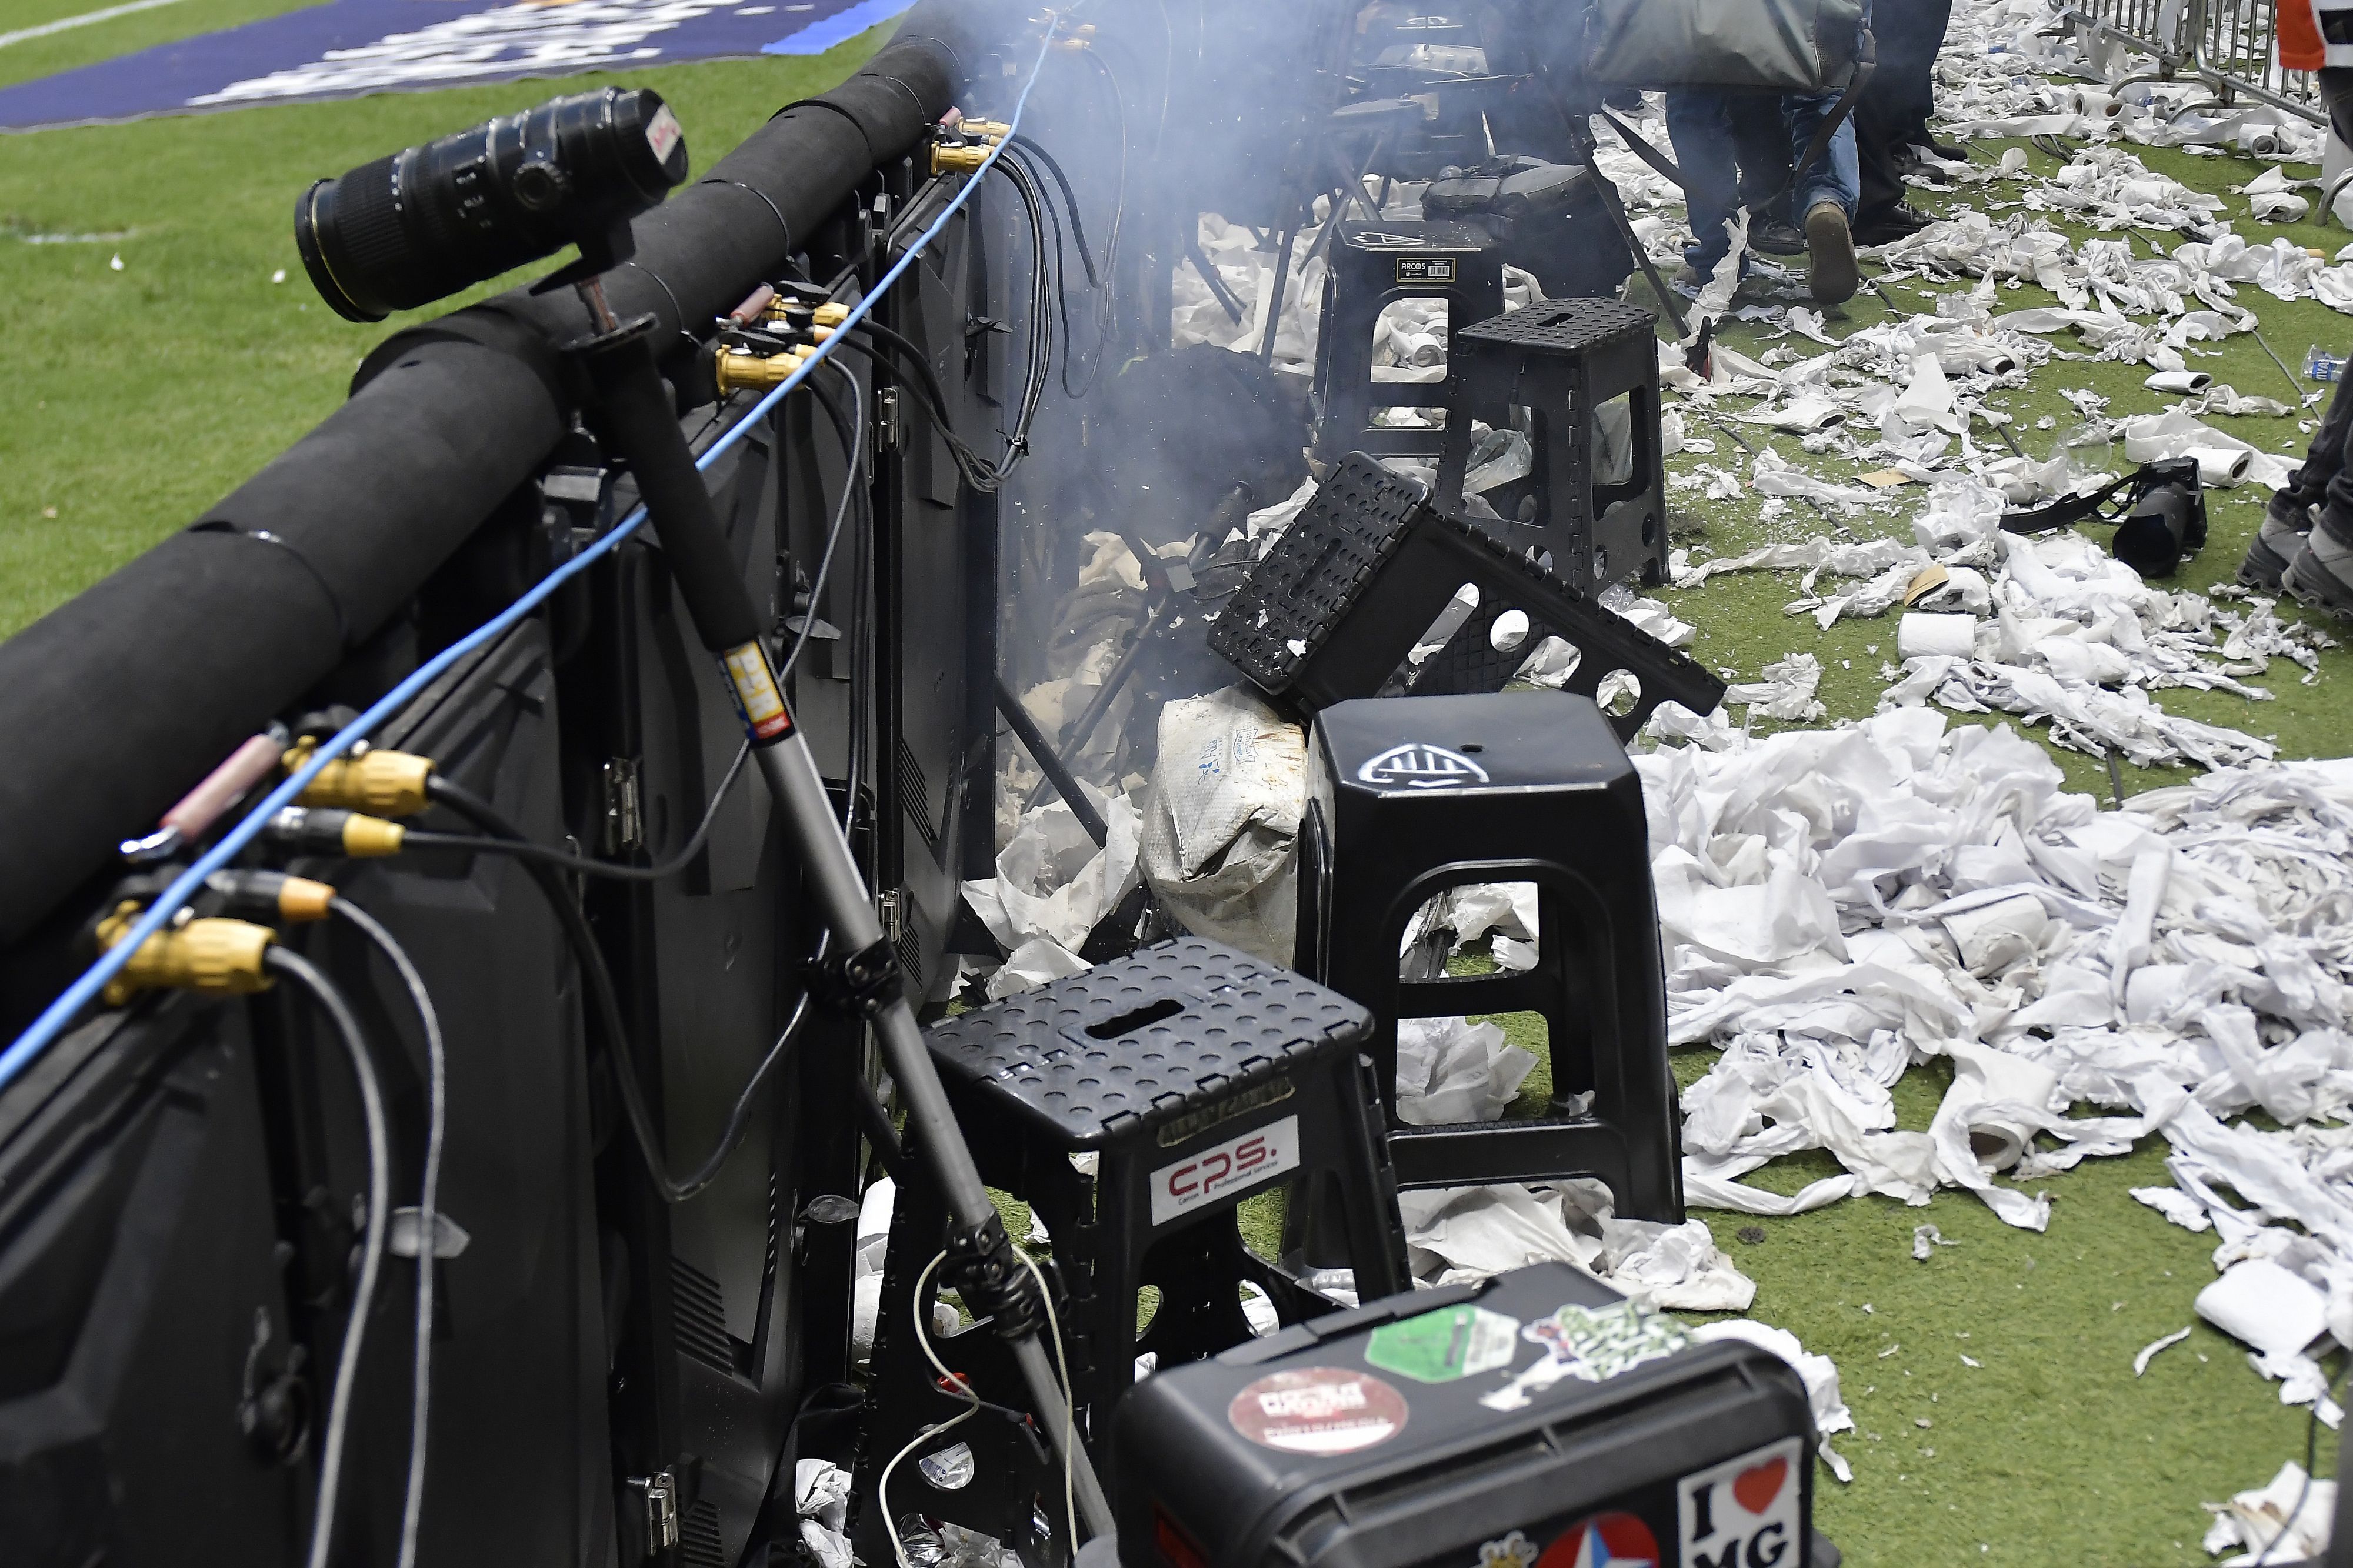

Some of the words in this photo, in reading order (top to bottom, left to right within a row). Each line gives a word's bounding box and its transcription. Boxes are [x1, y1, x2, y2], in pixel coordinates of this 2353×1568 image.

[1178, 1193, 1199, 1205] Canon
[1214, 1169, 1252, 1189] Professional
[1254, 1160, 1278, 1174] Services
[1692, 1482, 1715, 1544] I
